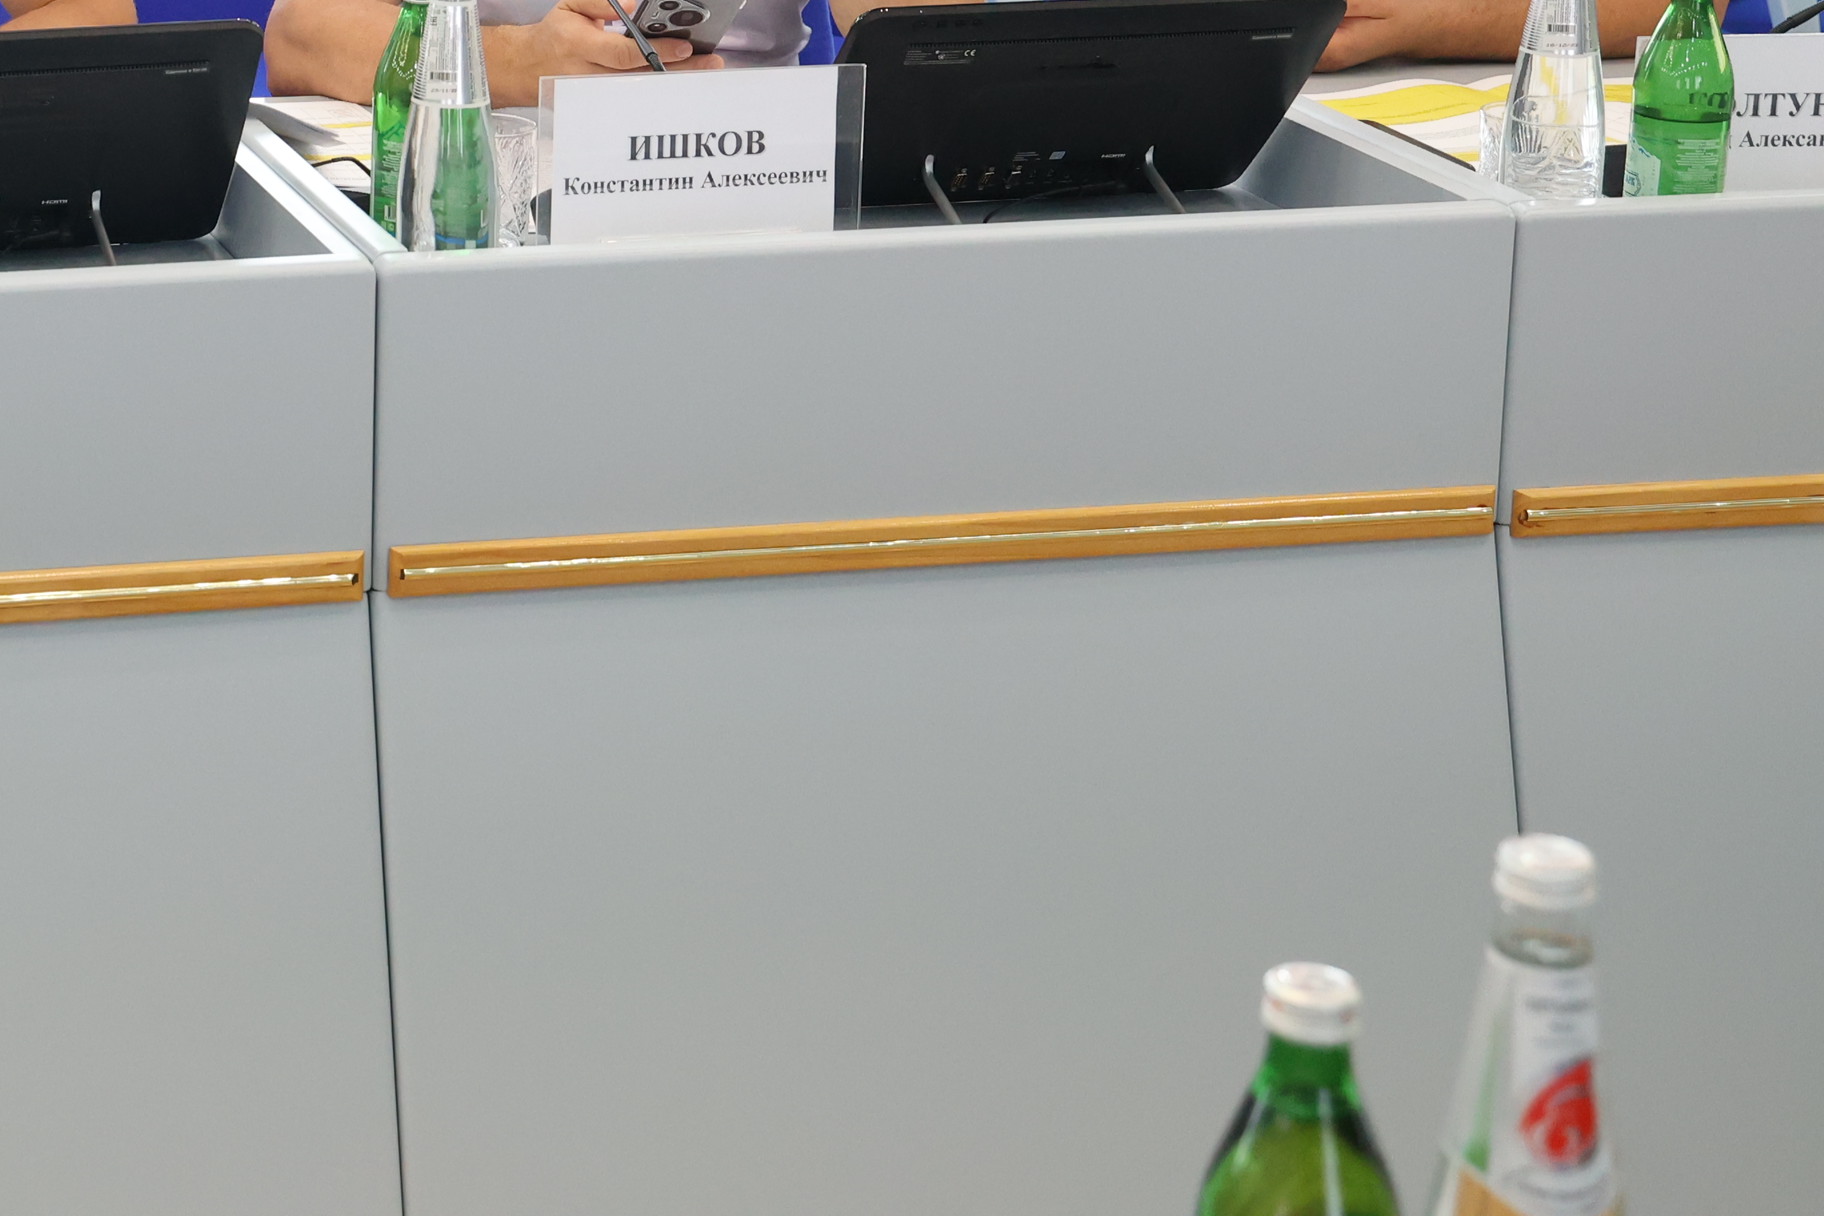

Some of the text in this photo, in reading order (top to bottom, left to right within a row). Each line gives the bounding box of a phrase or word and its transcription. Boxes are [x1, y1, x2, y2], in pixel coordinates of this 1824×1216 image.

[1732, 91, 1824, 118] ЛТУ
[627, 129, 767, 162] ИШКОВ
[563, 169, 829, 196] Константин Алексеевич
